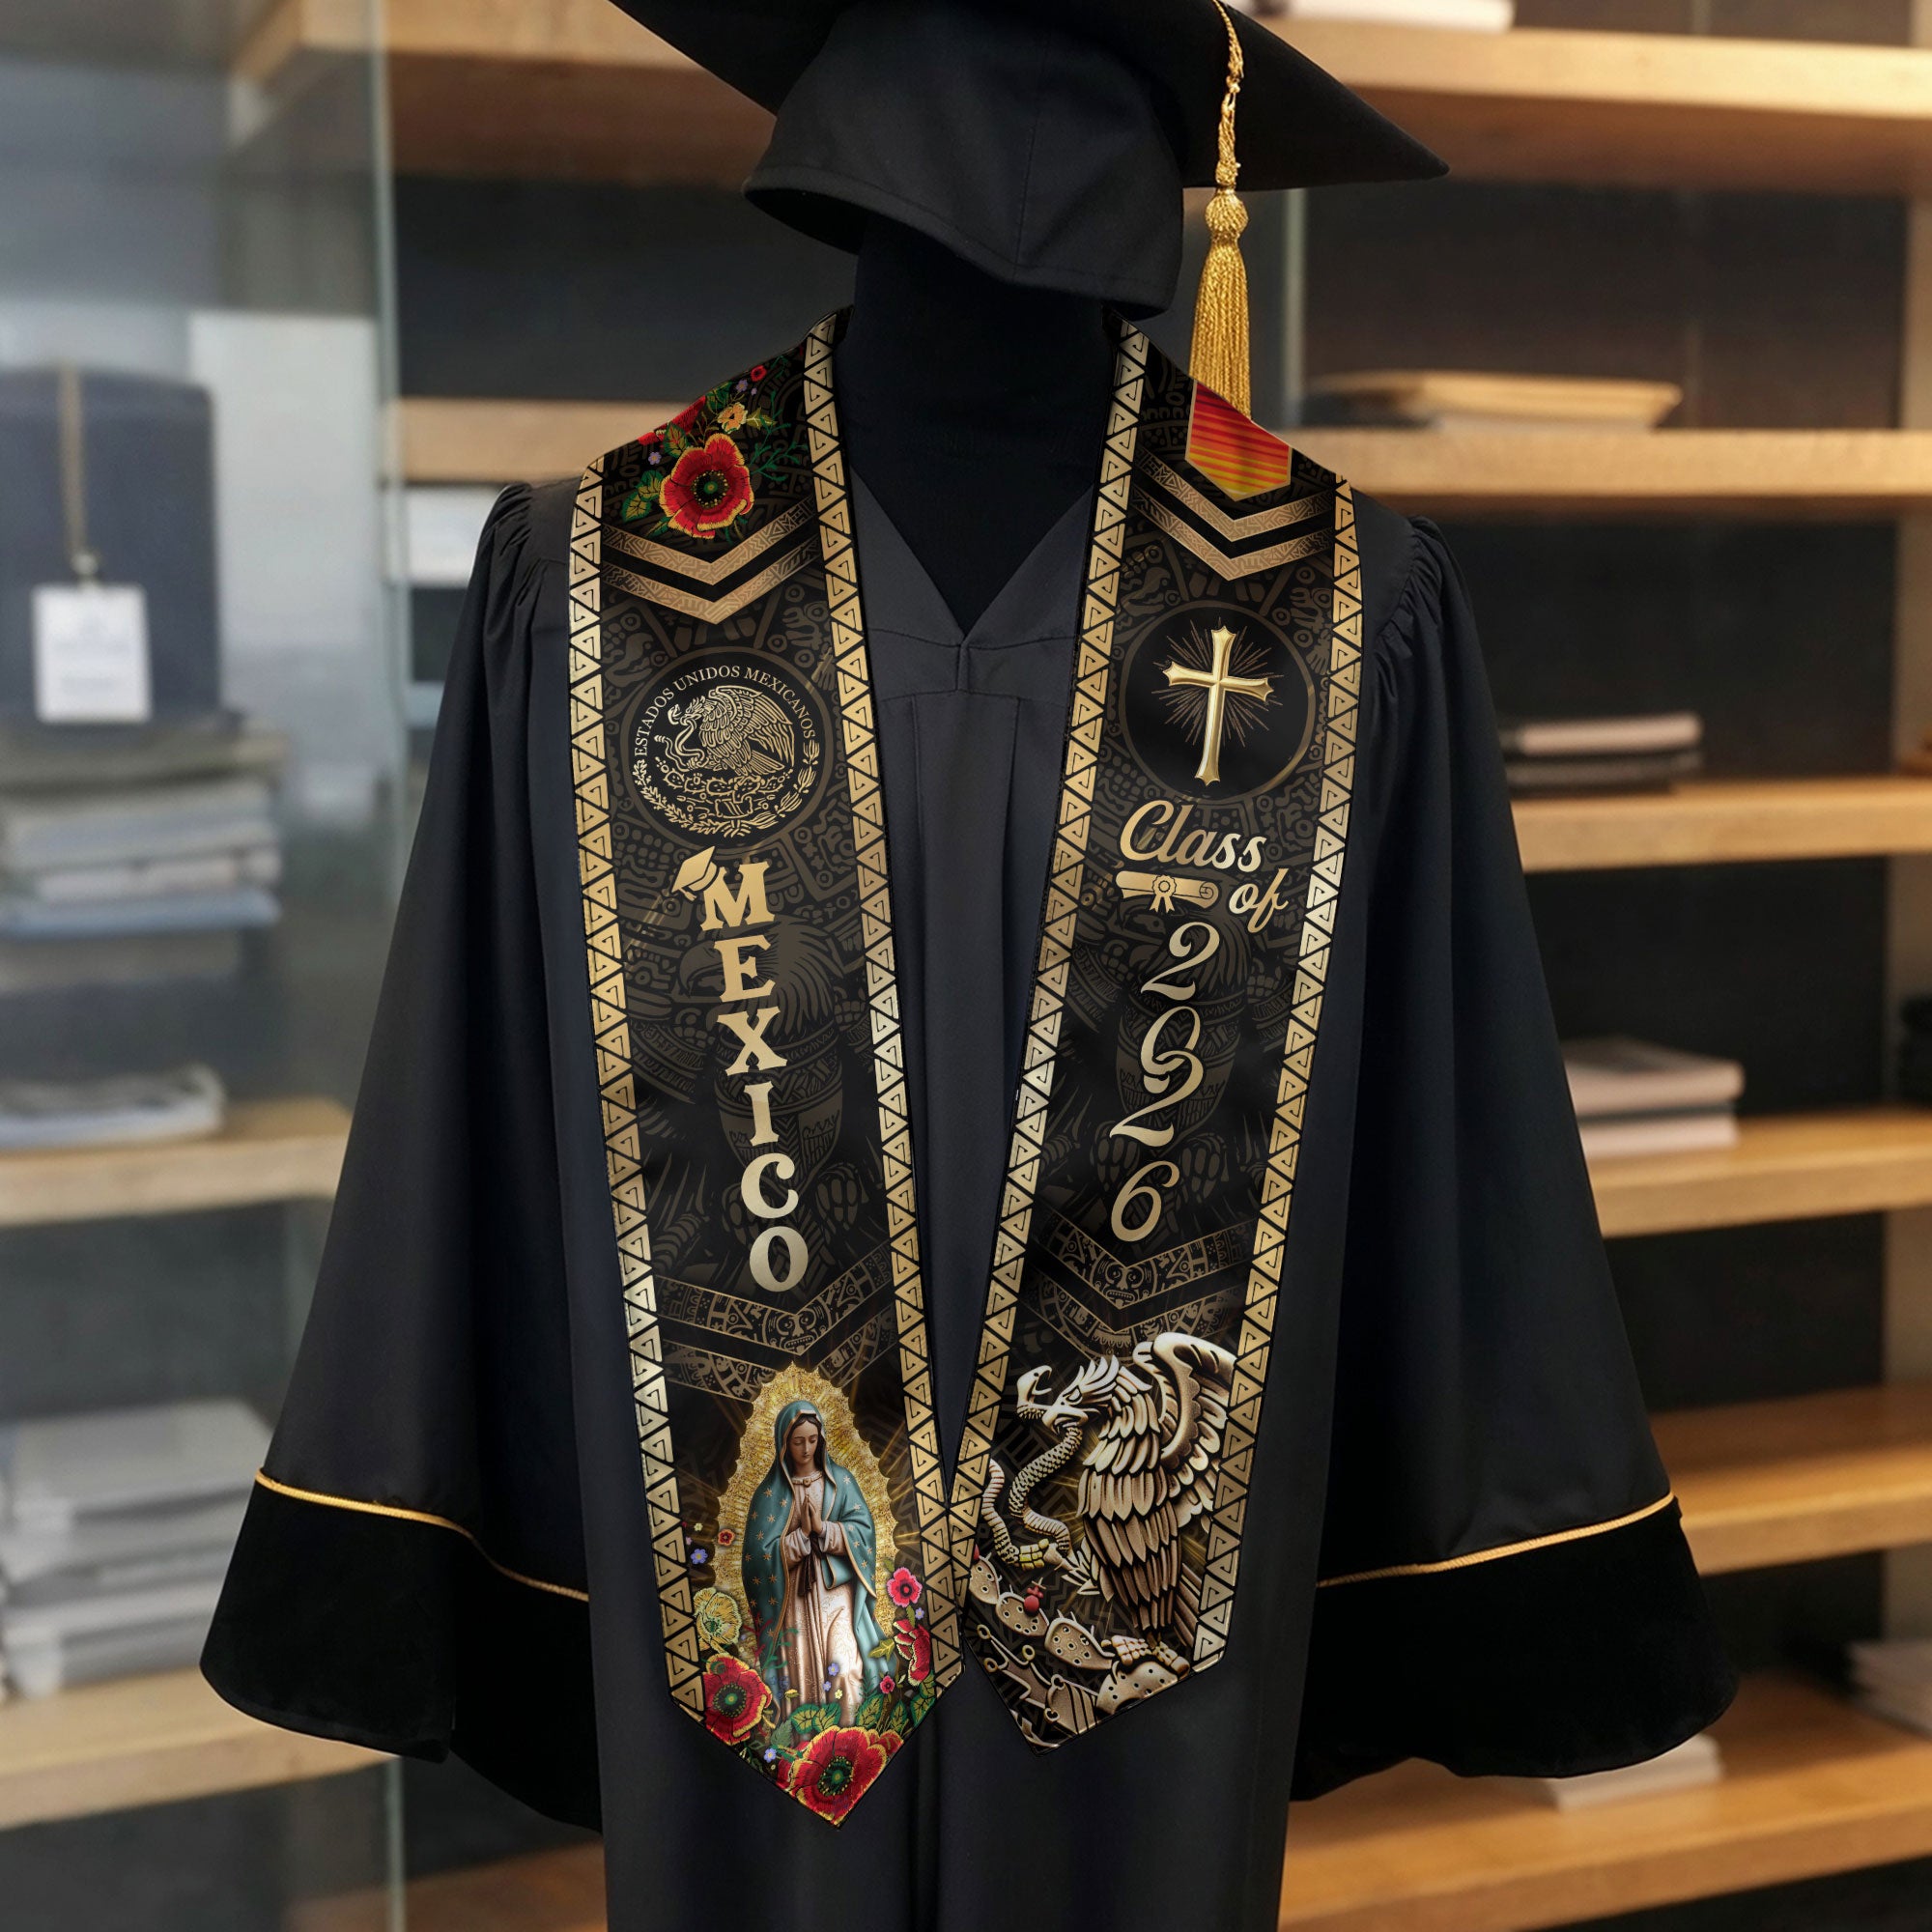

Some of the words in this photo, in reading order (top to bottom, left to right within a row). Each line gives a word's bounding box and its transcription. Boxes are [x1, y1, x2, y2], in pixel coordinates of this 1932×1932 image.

[635, 688, 674, 756] ESTADOS
[673, 665, 740, 692] UNIDOS
[745, 667, 816, 739] MEXICANOS
[1119, 799, 1267, 871] Class
[1228, 867, 1290, 934] of
[699, 861, 810, 1293] MEXICO
[1109, 921, 1221, 1242] 2026
